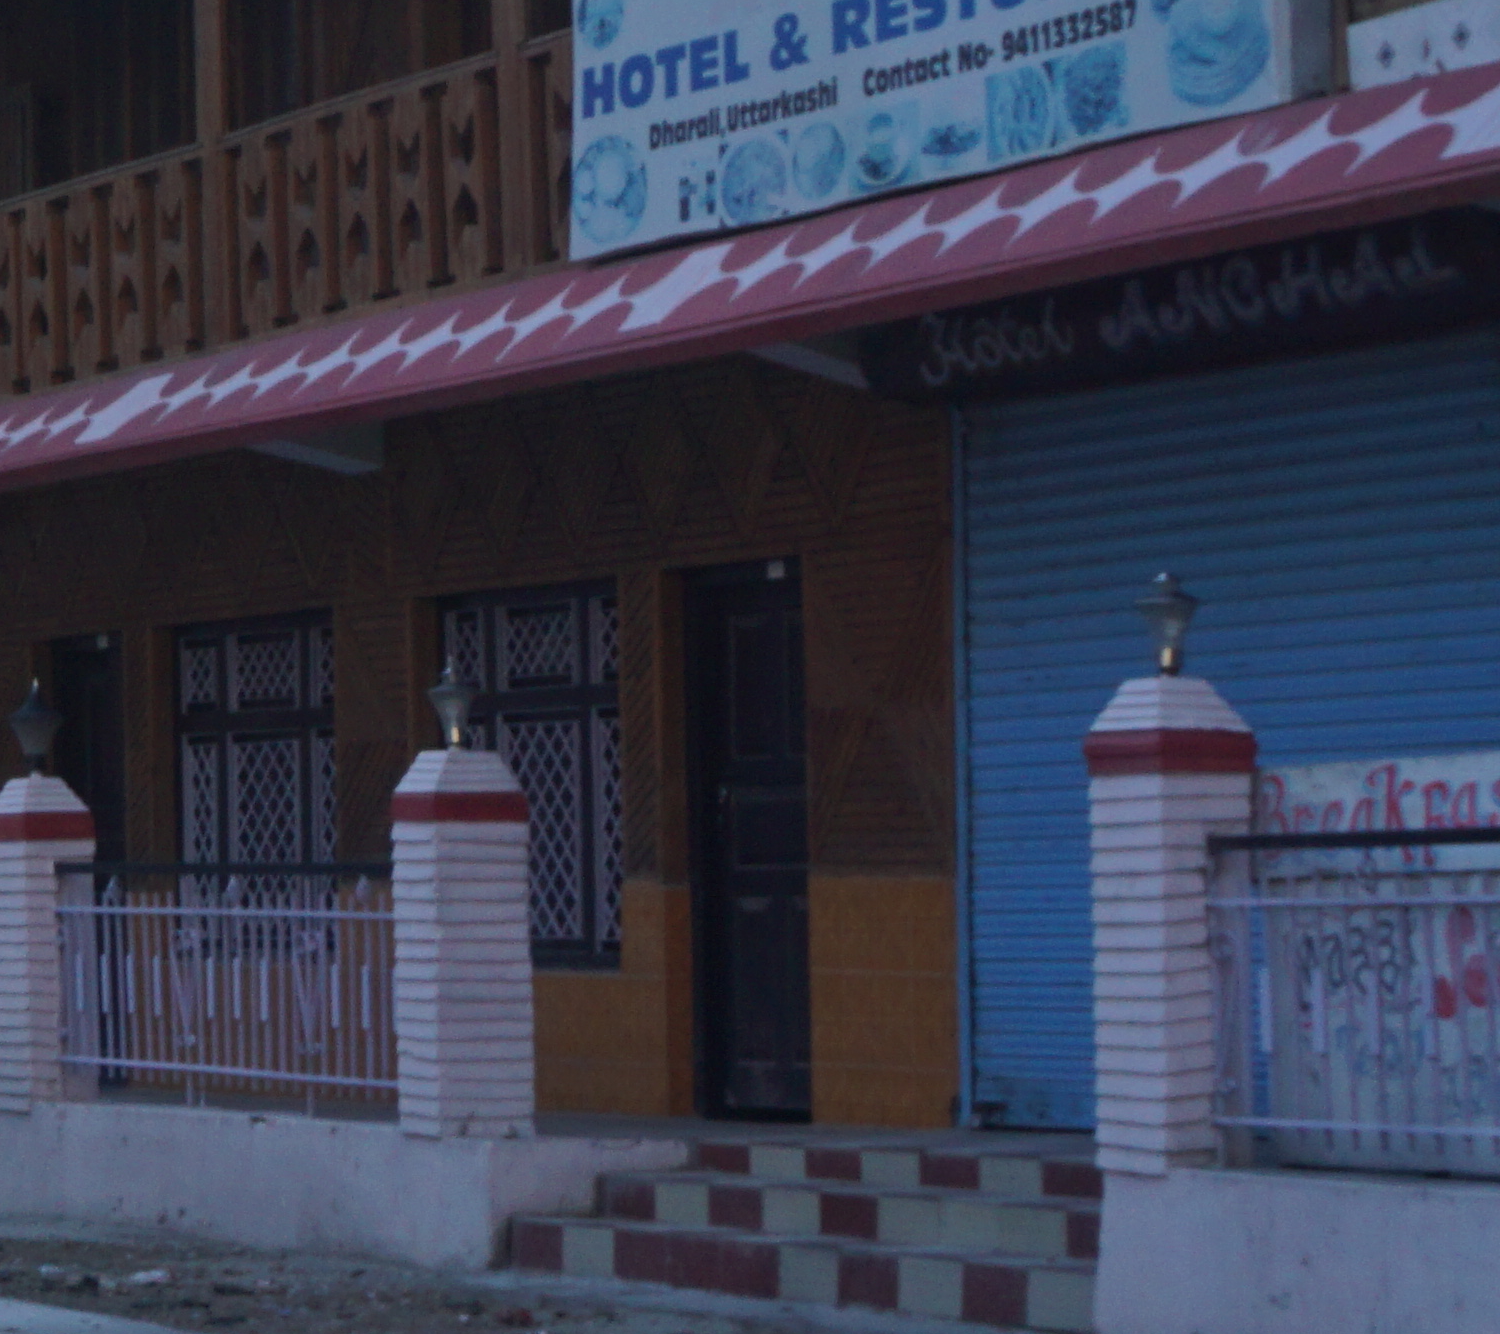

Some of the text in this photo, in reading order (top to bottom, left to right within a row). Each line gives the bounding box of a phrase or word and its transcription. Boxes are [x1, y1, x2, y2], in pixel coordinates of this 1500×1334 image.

[583, 30, 750, 119] HOTEL
[769, 12, 812, 72] &
[862, 51, 951, 97] Contact
